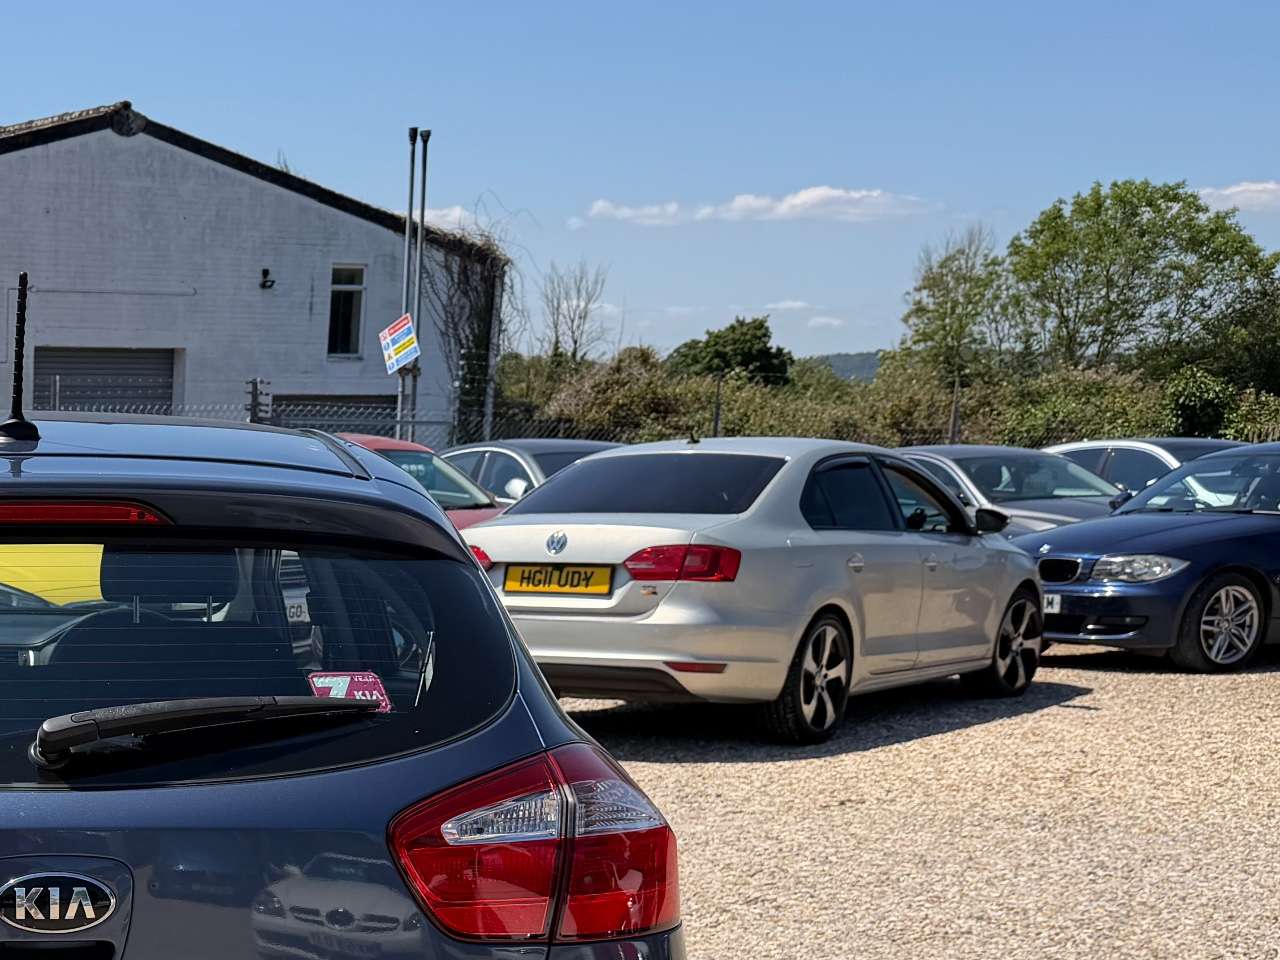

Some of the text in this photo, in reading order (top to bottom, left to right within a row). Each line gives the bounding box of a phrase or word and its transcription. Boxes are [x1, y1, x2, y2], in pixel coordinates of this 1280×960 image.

[558, 570, 594, 588] UDY
[353, 690, 384, 700] KIA
[14, 887, 96, 920] KIA
